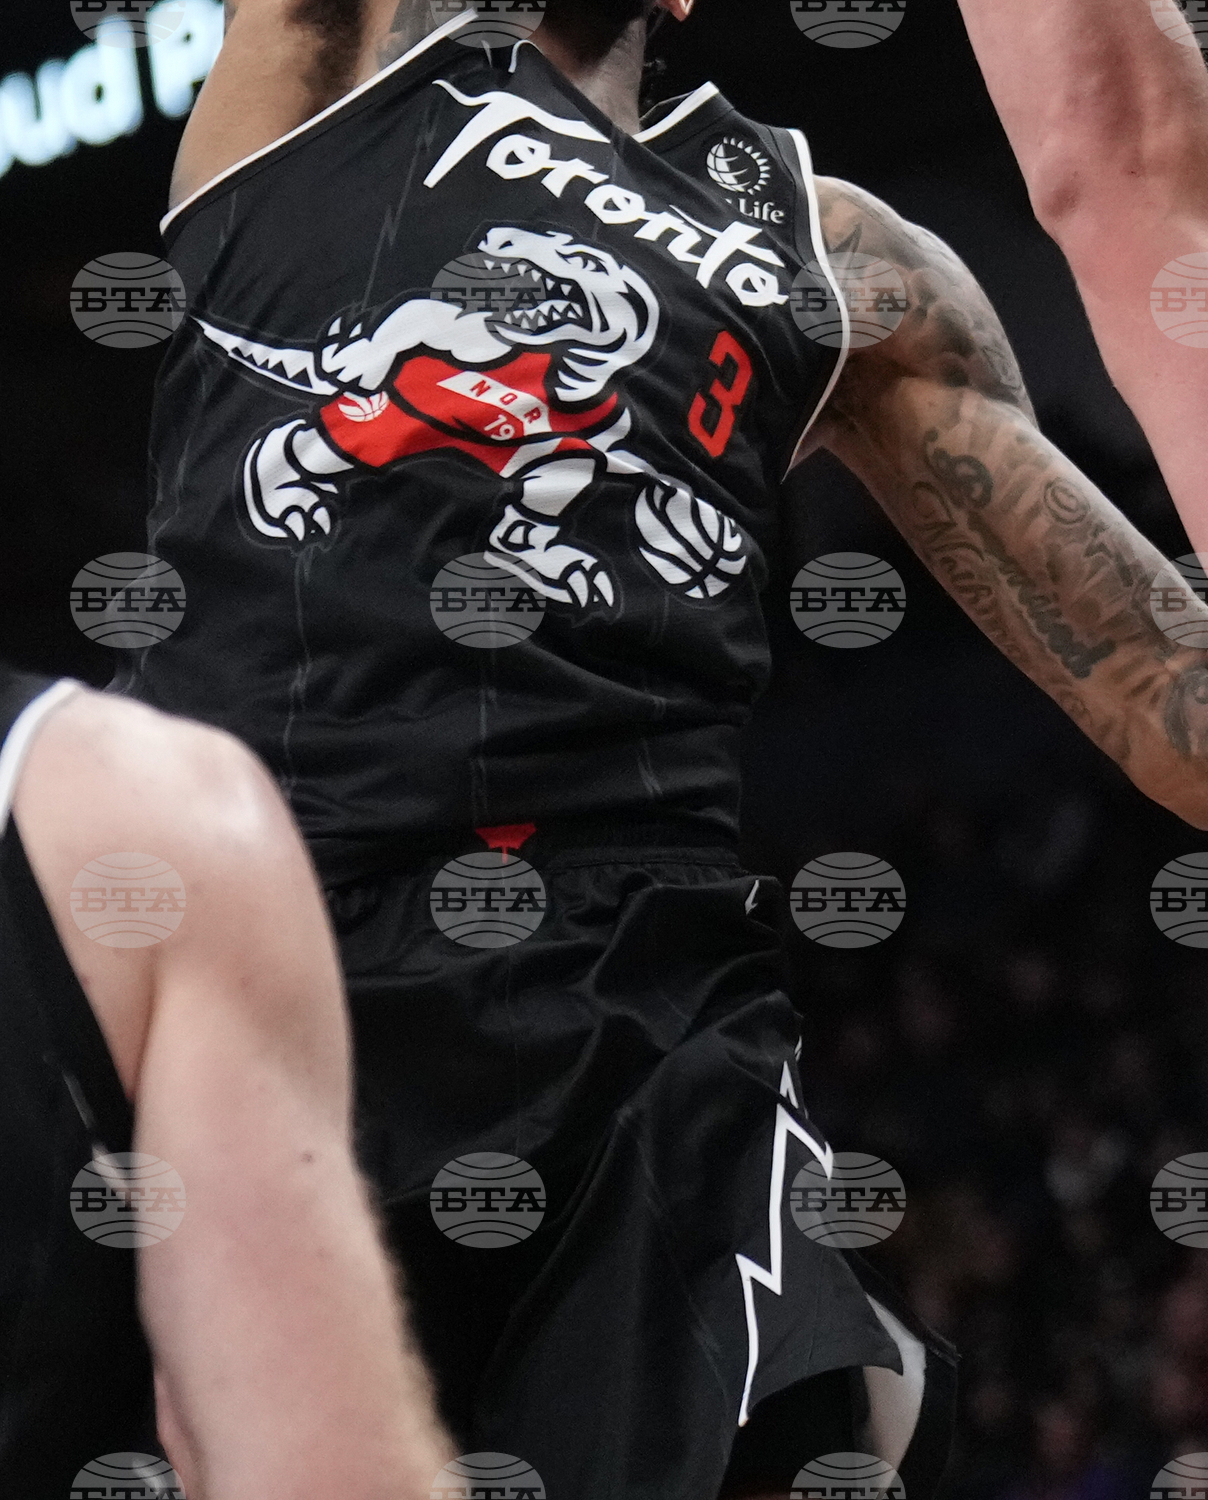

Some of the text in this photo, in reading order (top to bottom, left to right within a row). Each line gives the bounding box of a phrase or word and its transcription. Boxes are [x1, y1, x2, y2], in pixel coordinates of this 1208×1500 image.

[0, 14, 143, 178] ud
[423, 79, 789, 306] Toronto
[738, 198, 785, 224] Life
[483, 414, 515, 441] 19
[688, 329, 753, 459] 3
